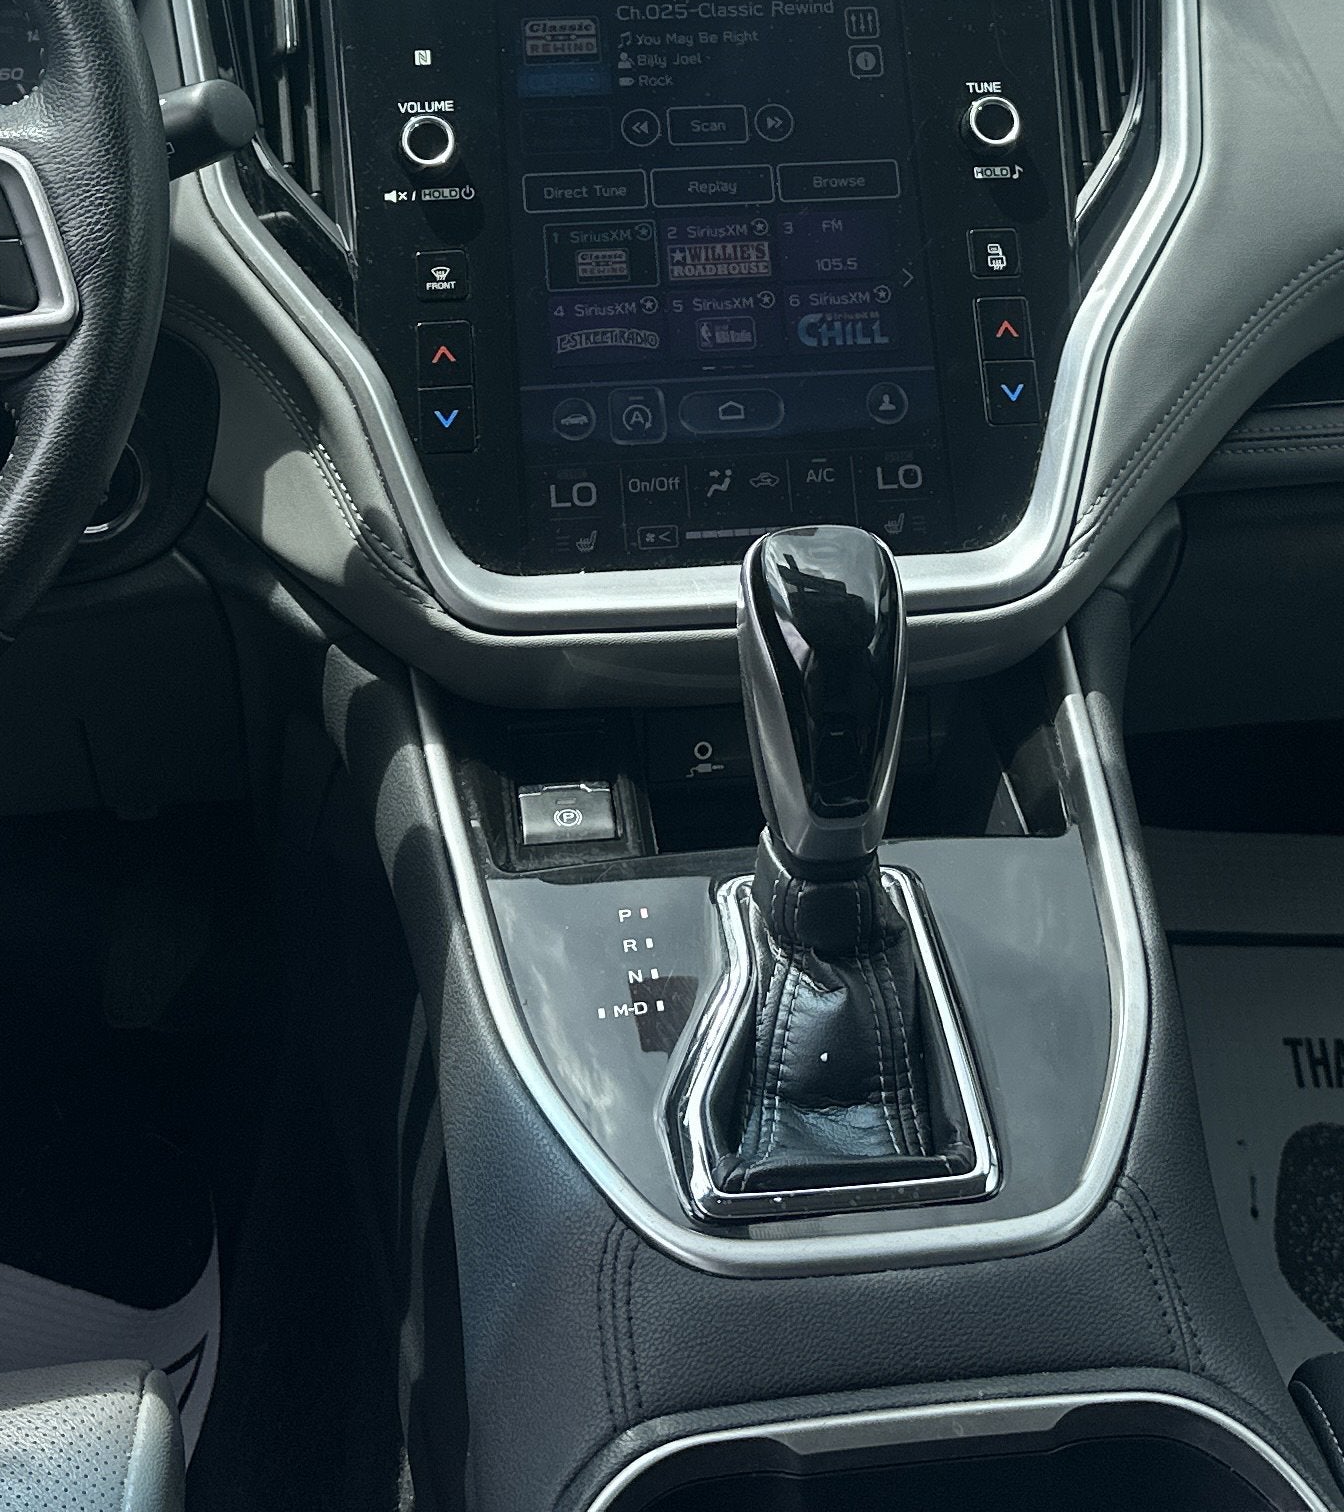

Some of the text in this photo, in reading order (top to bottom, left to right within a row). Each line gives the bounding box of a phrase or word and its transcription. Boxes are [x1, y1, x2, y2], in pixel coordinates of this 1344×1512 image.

[771, 0, 835, 17] Rewind
[636, 30, 760, 46] You May Be Right
[637, 52, 702, 68] Billy Joel
[638, 73, 674, 86] Rock
[965, 82, 1002, 93] TUNE
[397, 100, 454, 113] VOLUME
[690, 119, 727, 133] Scan
[975, 168, 1010, 178] HOLD
[688, 180, 738, 195] Replay
[812, 174, 866, 188] Browse
[422, 189, 459, 199] HOLD
[543, 184, 627, 199] Direct Tune
[667, 224, 748, 239] 2 SiriusXM
[784, 220, 843, 234] 3 FM
[569, 230, 631, 244] SiriusXM
[672, 262, 770, 278] ROADHOUSE
[816, 258, 858, 272] 105.5
[426, 281, 456, 290] FRONT
[672, 297, 754, 312] 5 SiriusXM
[789, 292, 870, 307] 6 SiriusXM
[553, 303, 636, 317] 4 SiriusXM
[798, 313, 889, 347] CHILL
[806, 467, 836, 484] A/C
[876, 464, 923, 490] LO
[628, 475, 681, 494] On/Off
[550, 482, 597, 508] LO
[618, 909, 632, 923] P
[623, 939, 638, 953] R
[628, 969, 643, 984] N
